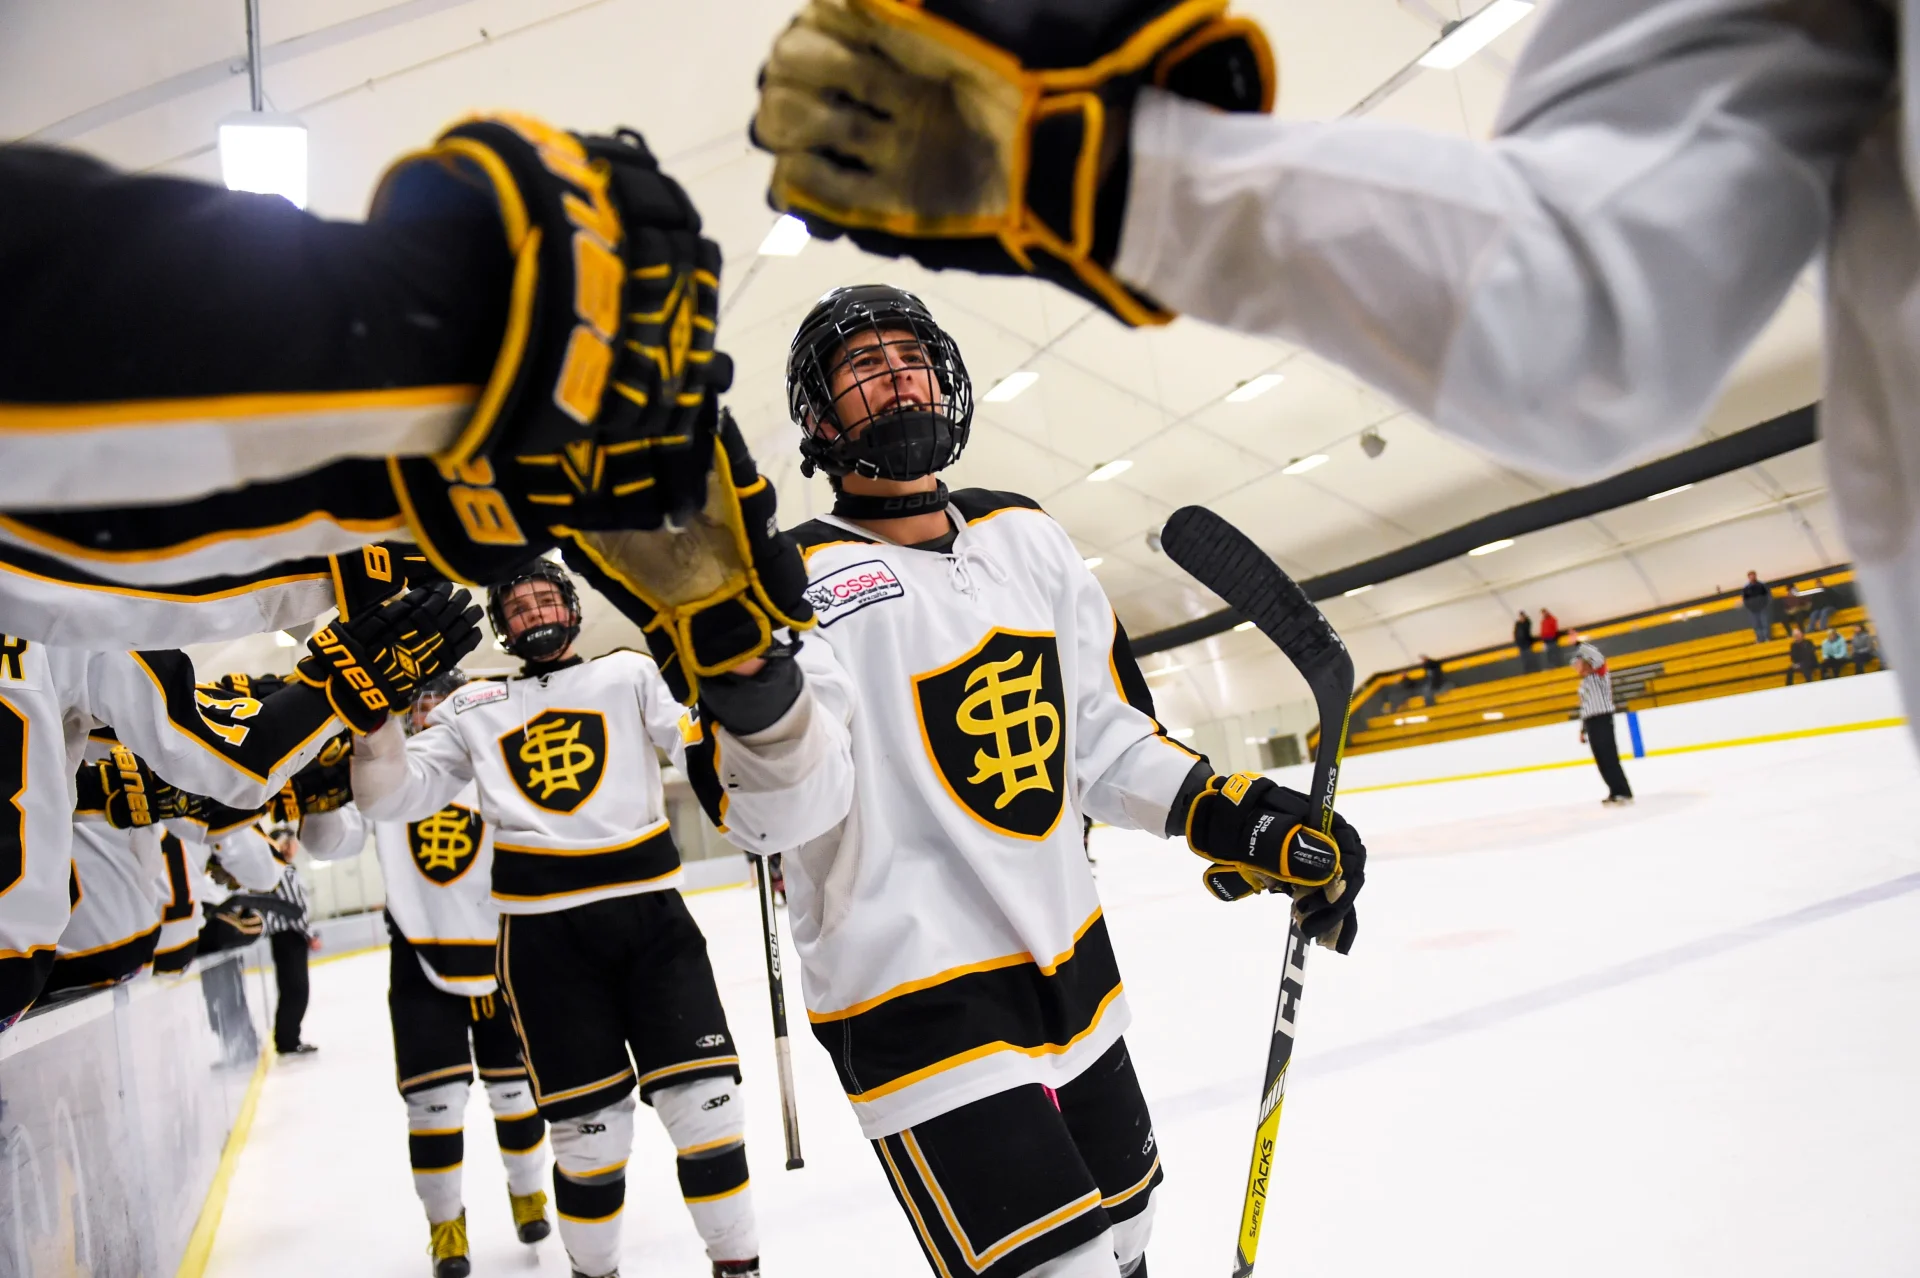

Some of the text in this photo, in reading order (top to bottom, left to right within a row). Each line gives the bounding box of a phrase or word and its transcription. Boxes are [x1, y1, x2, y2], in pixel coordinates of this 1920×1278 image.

[833, 571, 896, 598] CSSHL
[1322, 767, 1337, 810] TACKS
[1249, 814, 1269, 857] NEXUS
[770, 933, 780, 972] CCM
[1249, 1136, 1274, 1238] SUPER TACKS
